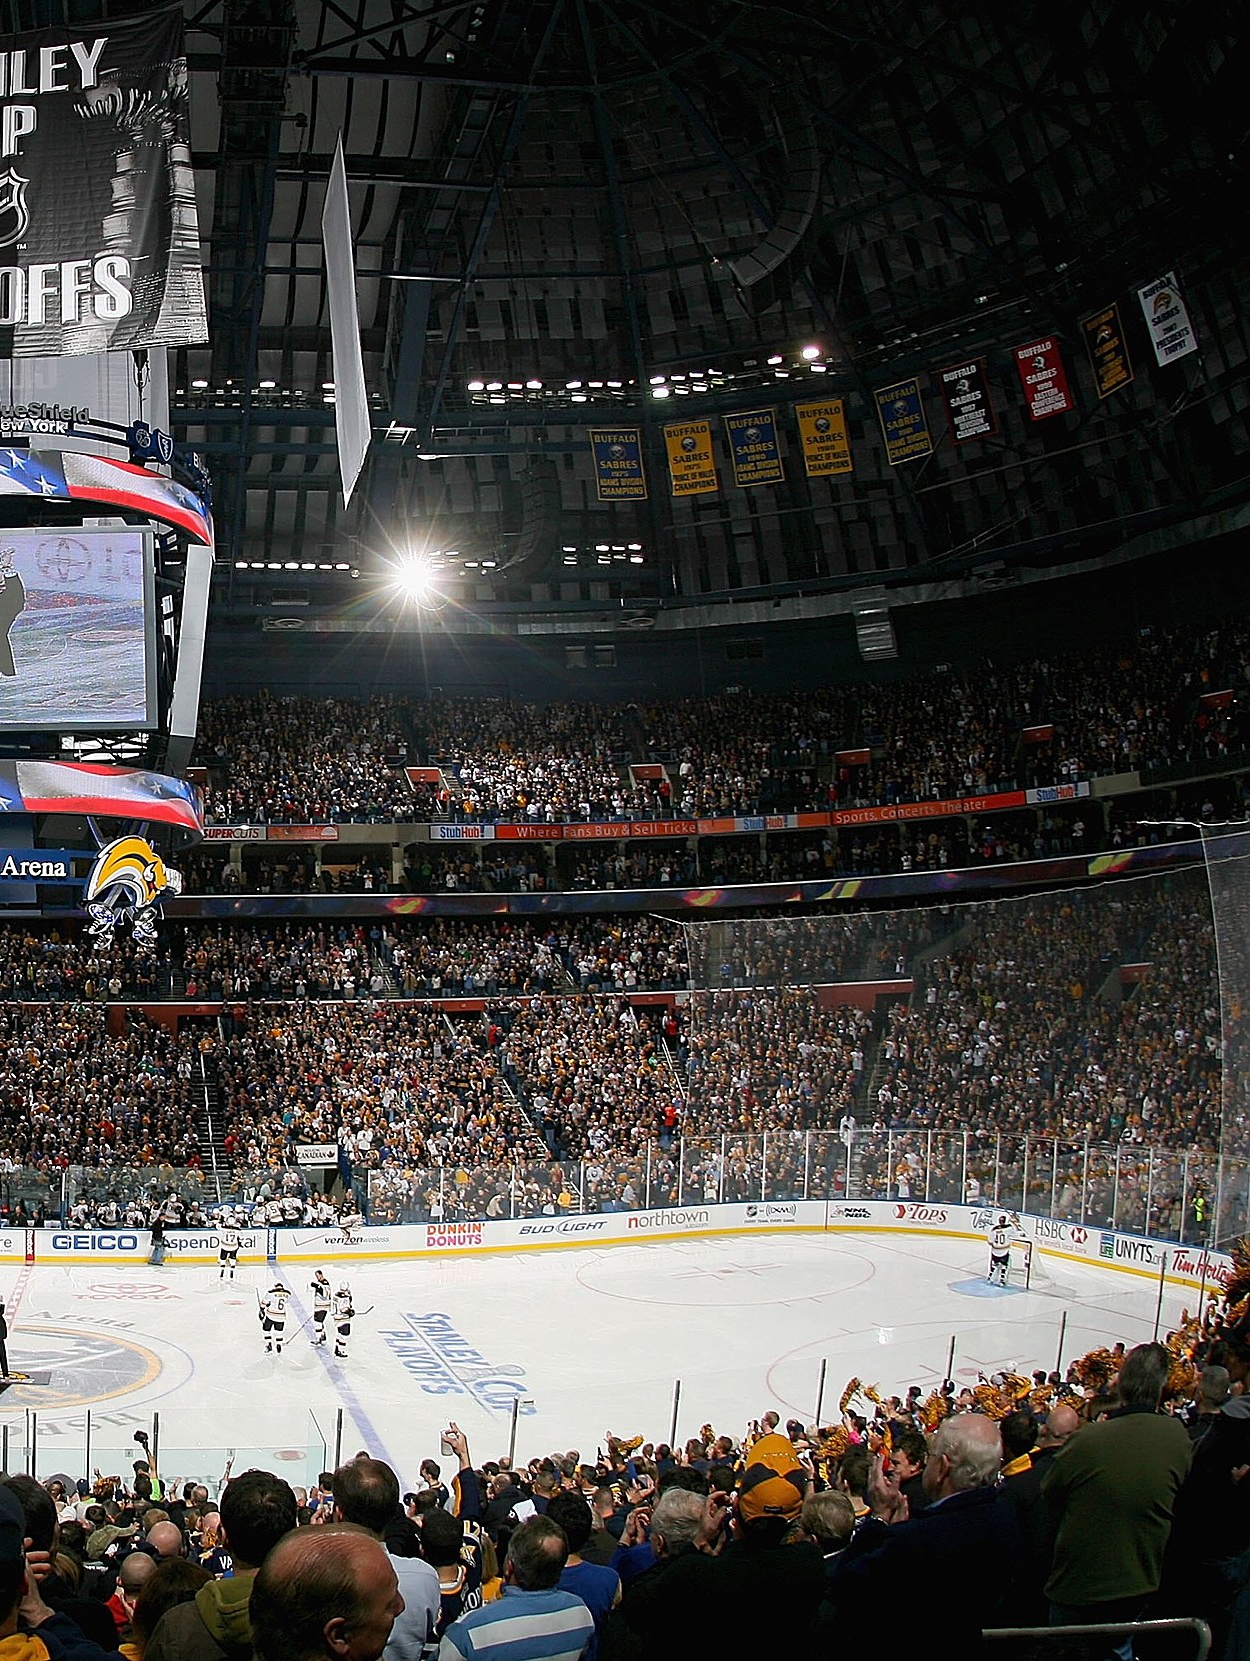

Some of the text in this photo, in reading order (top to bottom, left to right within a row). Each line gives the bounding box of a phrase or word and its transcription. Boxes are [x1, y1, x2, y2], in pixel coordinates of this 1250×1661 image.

[1152, 306, 1180, 327] SABRES
[1018, 341, 1051, 359] BUFFALO
[943, 365, 976, 382] BUFFALO
[1026, 368, 1057, 384] SABRES
[878, 385, 916, 404] BUFFALO
[950, 391, 982, 407] SABRES
[799, 406, 841, 419] BUFFALO
[28, 418, 68, 434] York
[730, 415, 771, 429] BUFFALO
[886, 413, 921, 431] SABRES
[594, 434, 636, 443] BUFFALO
[666, 426, 707, 438] BUFFALO
[807, 432, 844, 445] SABRES
[736, 442, 774, 455] SABRES
[600, 461, 638, 469] SABRES
[673, 452, 710, 464] SABRES
[601, 486, 643, 495] CHAMPIONS
[674, 479, 716, 492] CHAMPIONS
[1036, 784, 1078, 801] StubHub!
[835, 799, 986, 825] Sports, Concerts, Theater
[517, 826, 557, 838] Where
[563, 826, 592, 837] Fans
[596, 824, 619, 837] Buy
[622, 825, 630, 836] &
[634, 823, 657, 835] Sell
[743, 816, 787, 830] StubHub!
[203, 826, 259, 839] SUPERCUTS
[440, 825, 485, 838] StubHub!
[0, 855, 67, 877] Arena
[628, 1210, 709, 1229] northtown
[427, 1223, 485, 1236] DUNKIN'
[519, 1220, 608, 1235] BUD LIGHT
[1035, 1219, 1067, 1240] HSBC
[52, 1234, 138, 1251] GEICO
[225, 1234, 236, 1243] 17
[324, 1234, 363, 1246] verizon
[427, 1234, 482, 1247] DONUTS
[1172, 1250, 1195, 1275] Tim
[278, 1299, 285, 1310] 6
[378, 1330, 464, 1394] PLAYOFFS
[406, 1313, 537, 1416] STANLEY CUP
